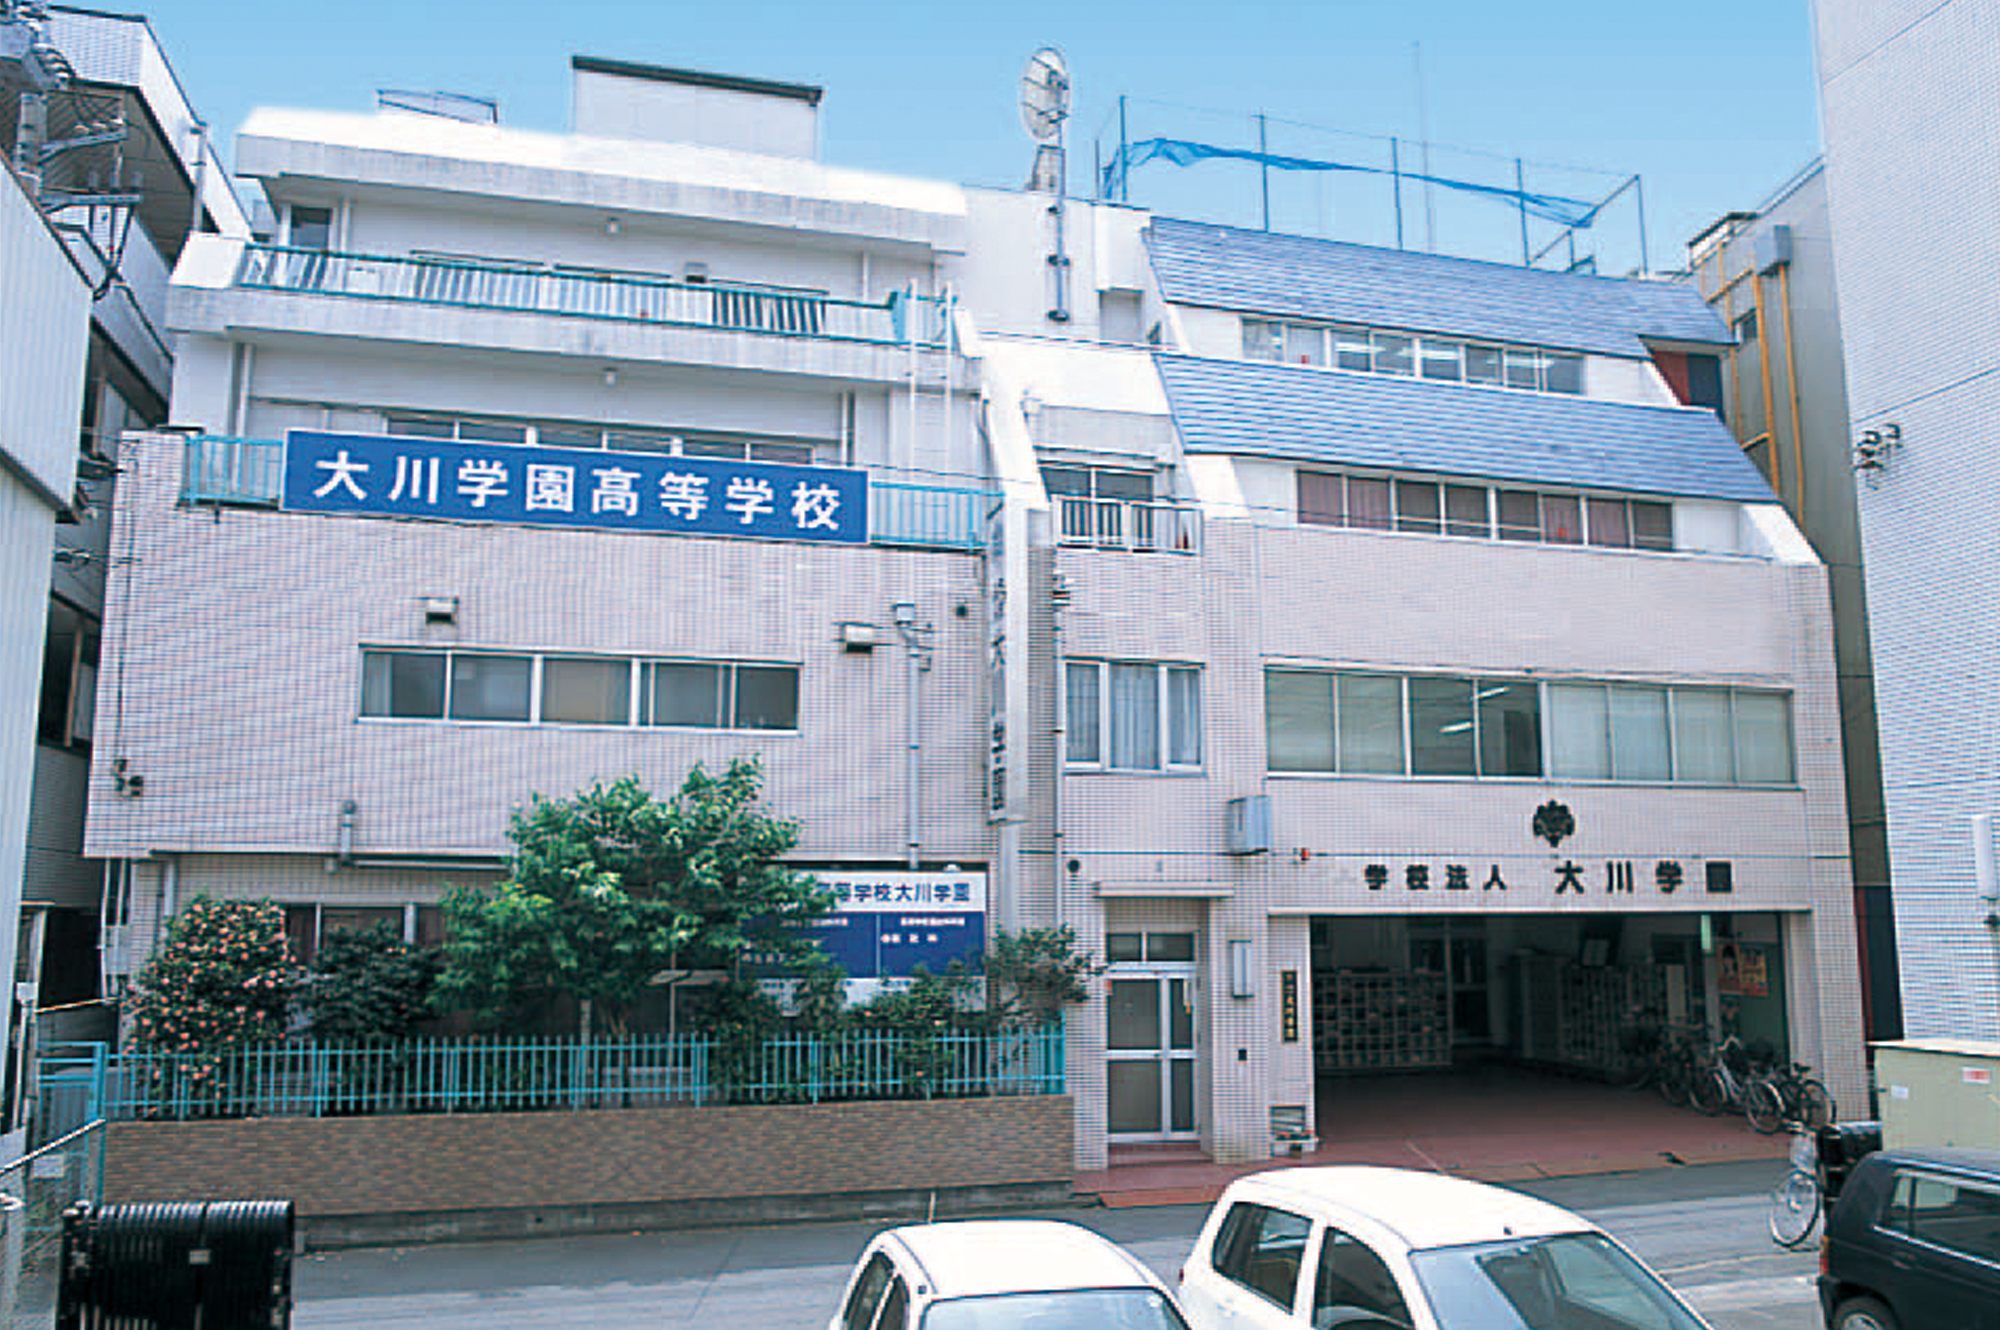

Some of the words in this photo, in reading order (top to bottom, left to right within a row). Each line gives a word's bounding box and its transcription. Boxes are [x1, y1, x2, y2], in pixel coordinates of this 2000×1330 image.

[312, 451, 840, 530] 大川学園高等学校
[1364, 864, 1507, 891] 学校法人
[1554, 860, 1733, 895] 大川学園
